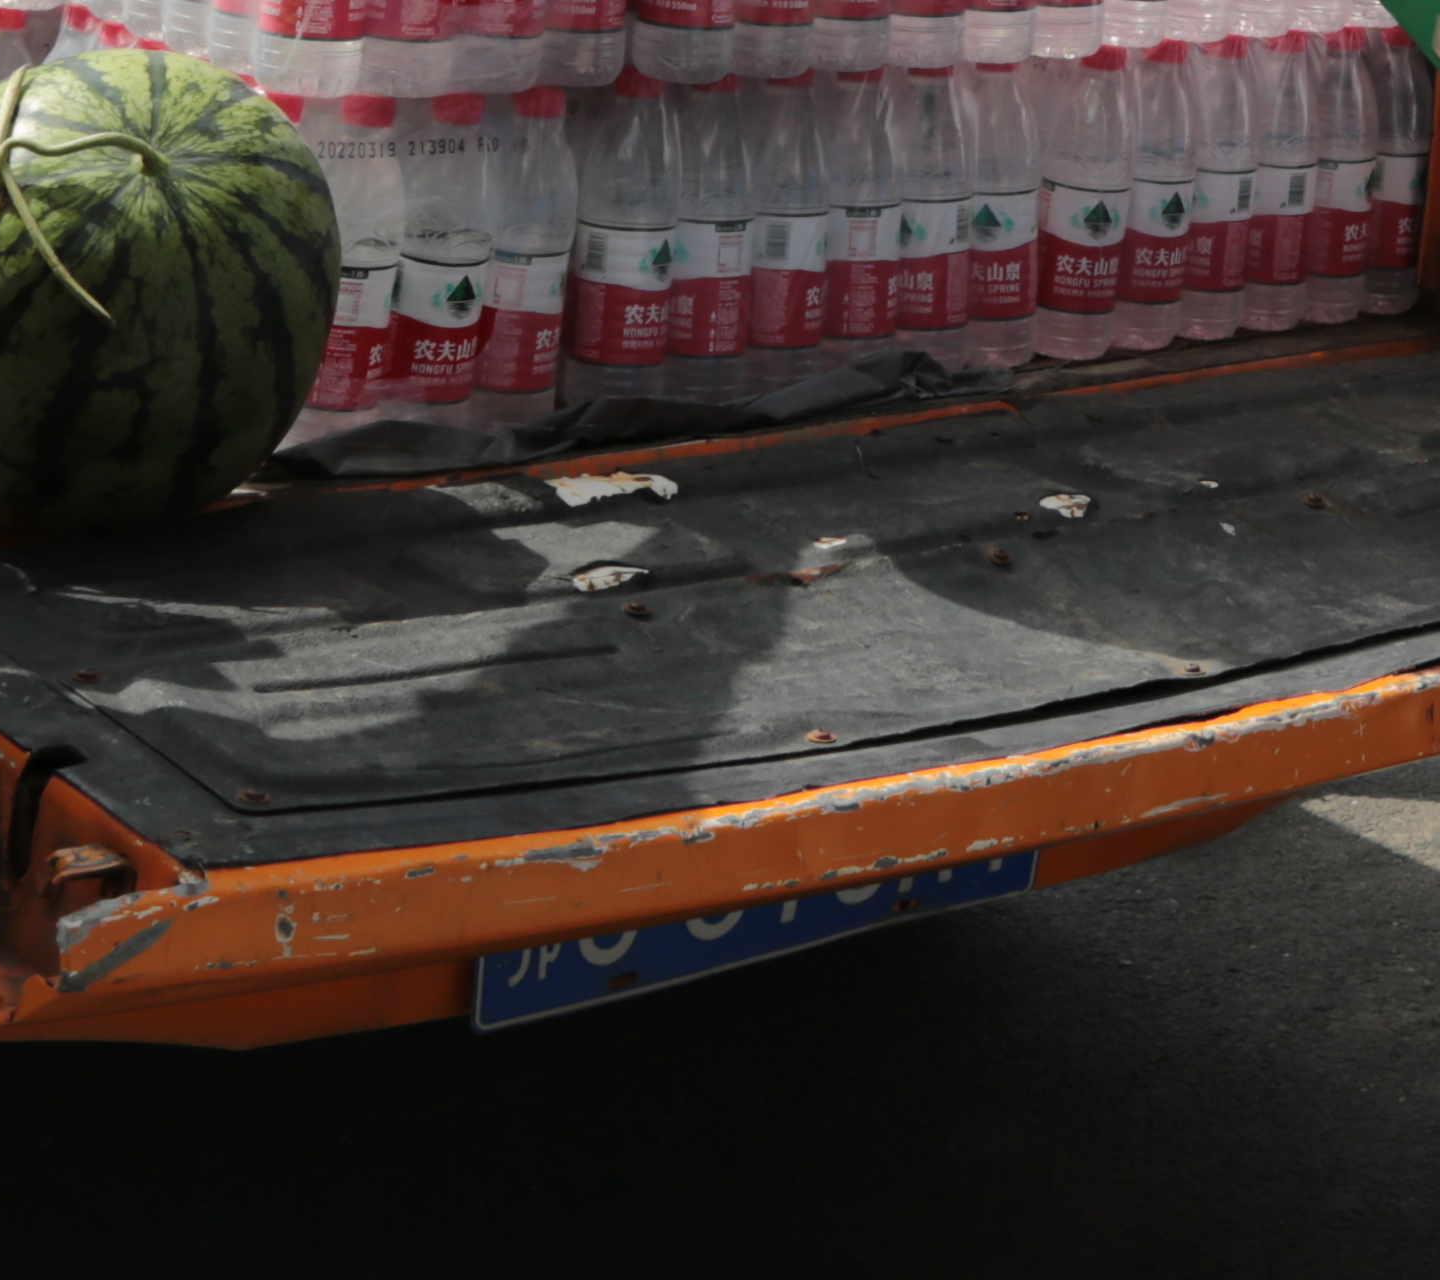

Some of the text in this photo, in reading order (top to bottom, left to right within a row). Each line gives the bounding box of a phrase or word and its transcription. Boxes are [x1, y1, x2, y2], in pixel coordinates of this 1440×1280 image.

[317, 140, 397, 160] 20220319
[408, 138, 466, 157] 213904
[971, 261, 1021, 282] 夫山泉
[987, 282, 1021, 293] SPRING
[1053, 275, 1091, 288] NONGFU
[622, 327, 659, 338] NONGFU
[410, 362, 453, 376] NONGFU
